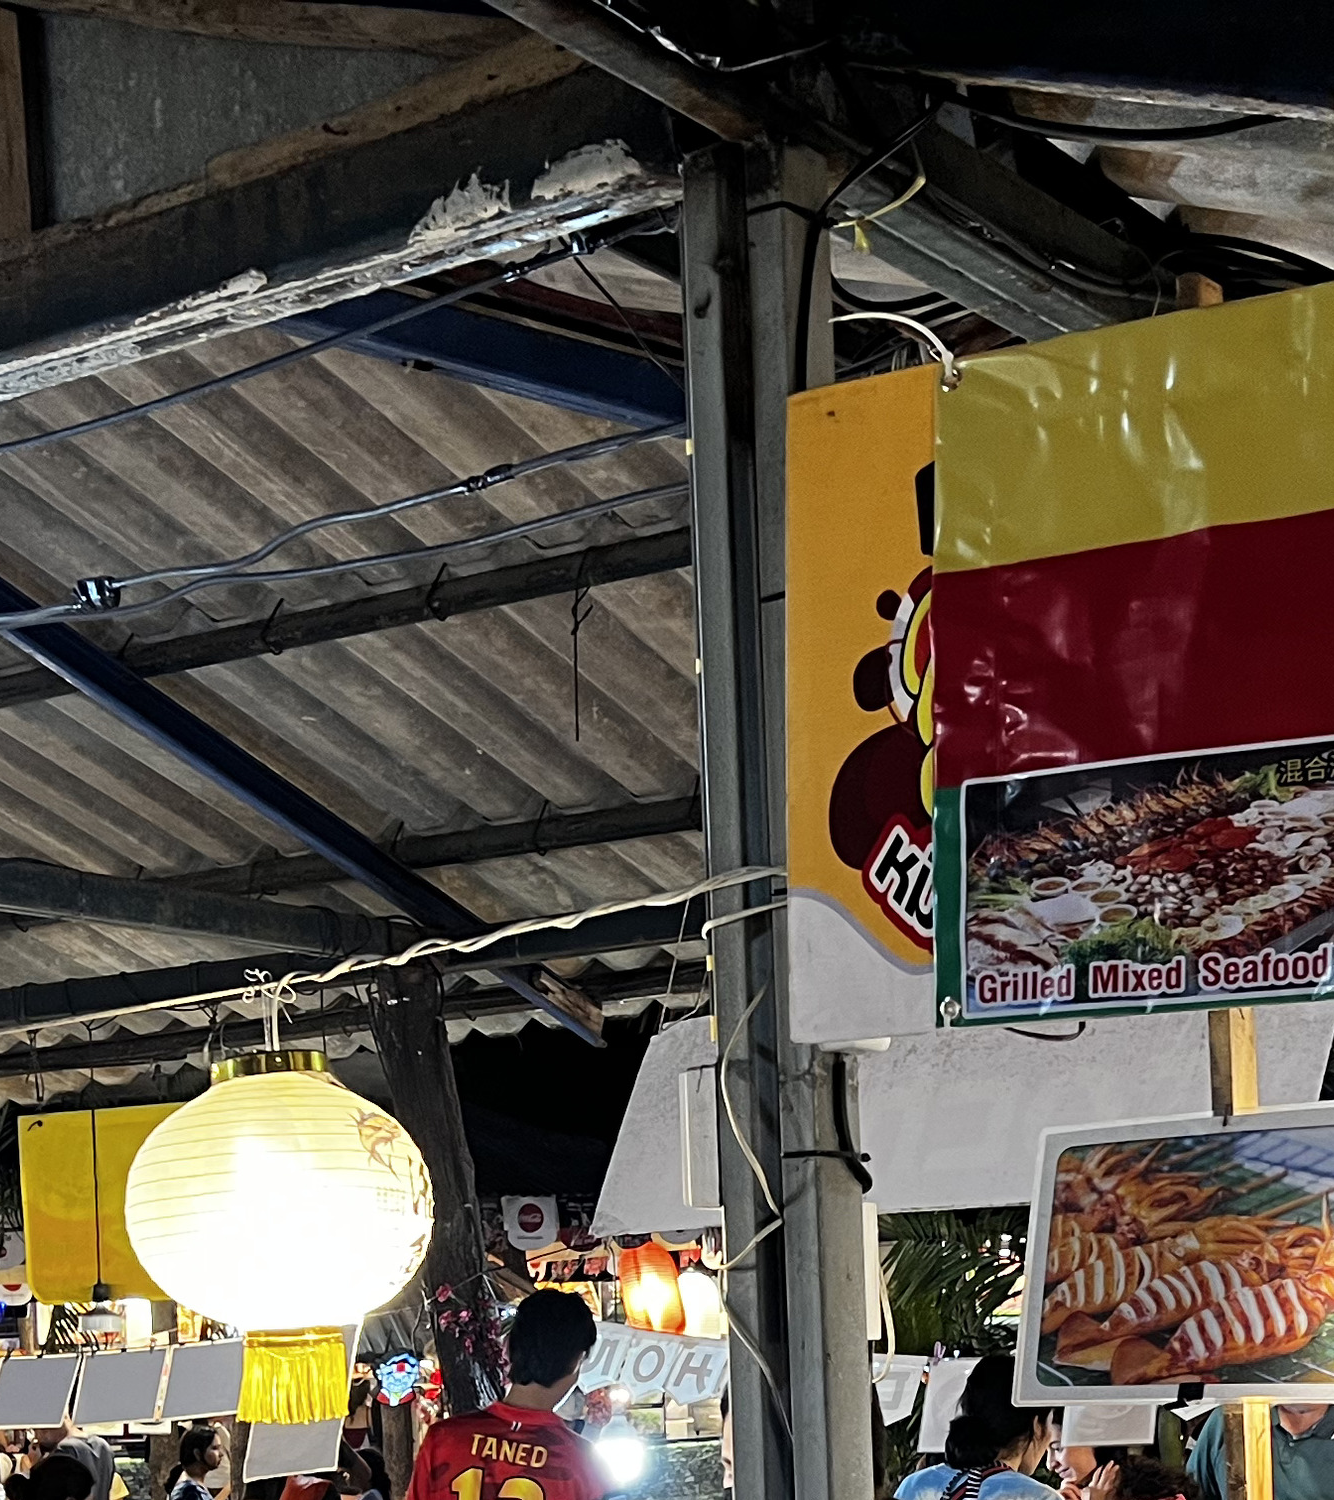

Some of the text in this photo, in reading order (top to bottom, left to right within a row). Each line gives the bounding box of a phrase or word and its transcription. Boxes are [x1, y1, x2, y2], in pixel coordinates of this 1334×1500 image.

[978, 946, 1331, 1003] Grilled Mixed Seafood
[471, 1433, 547, 1469] TANED
